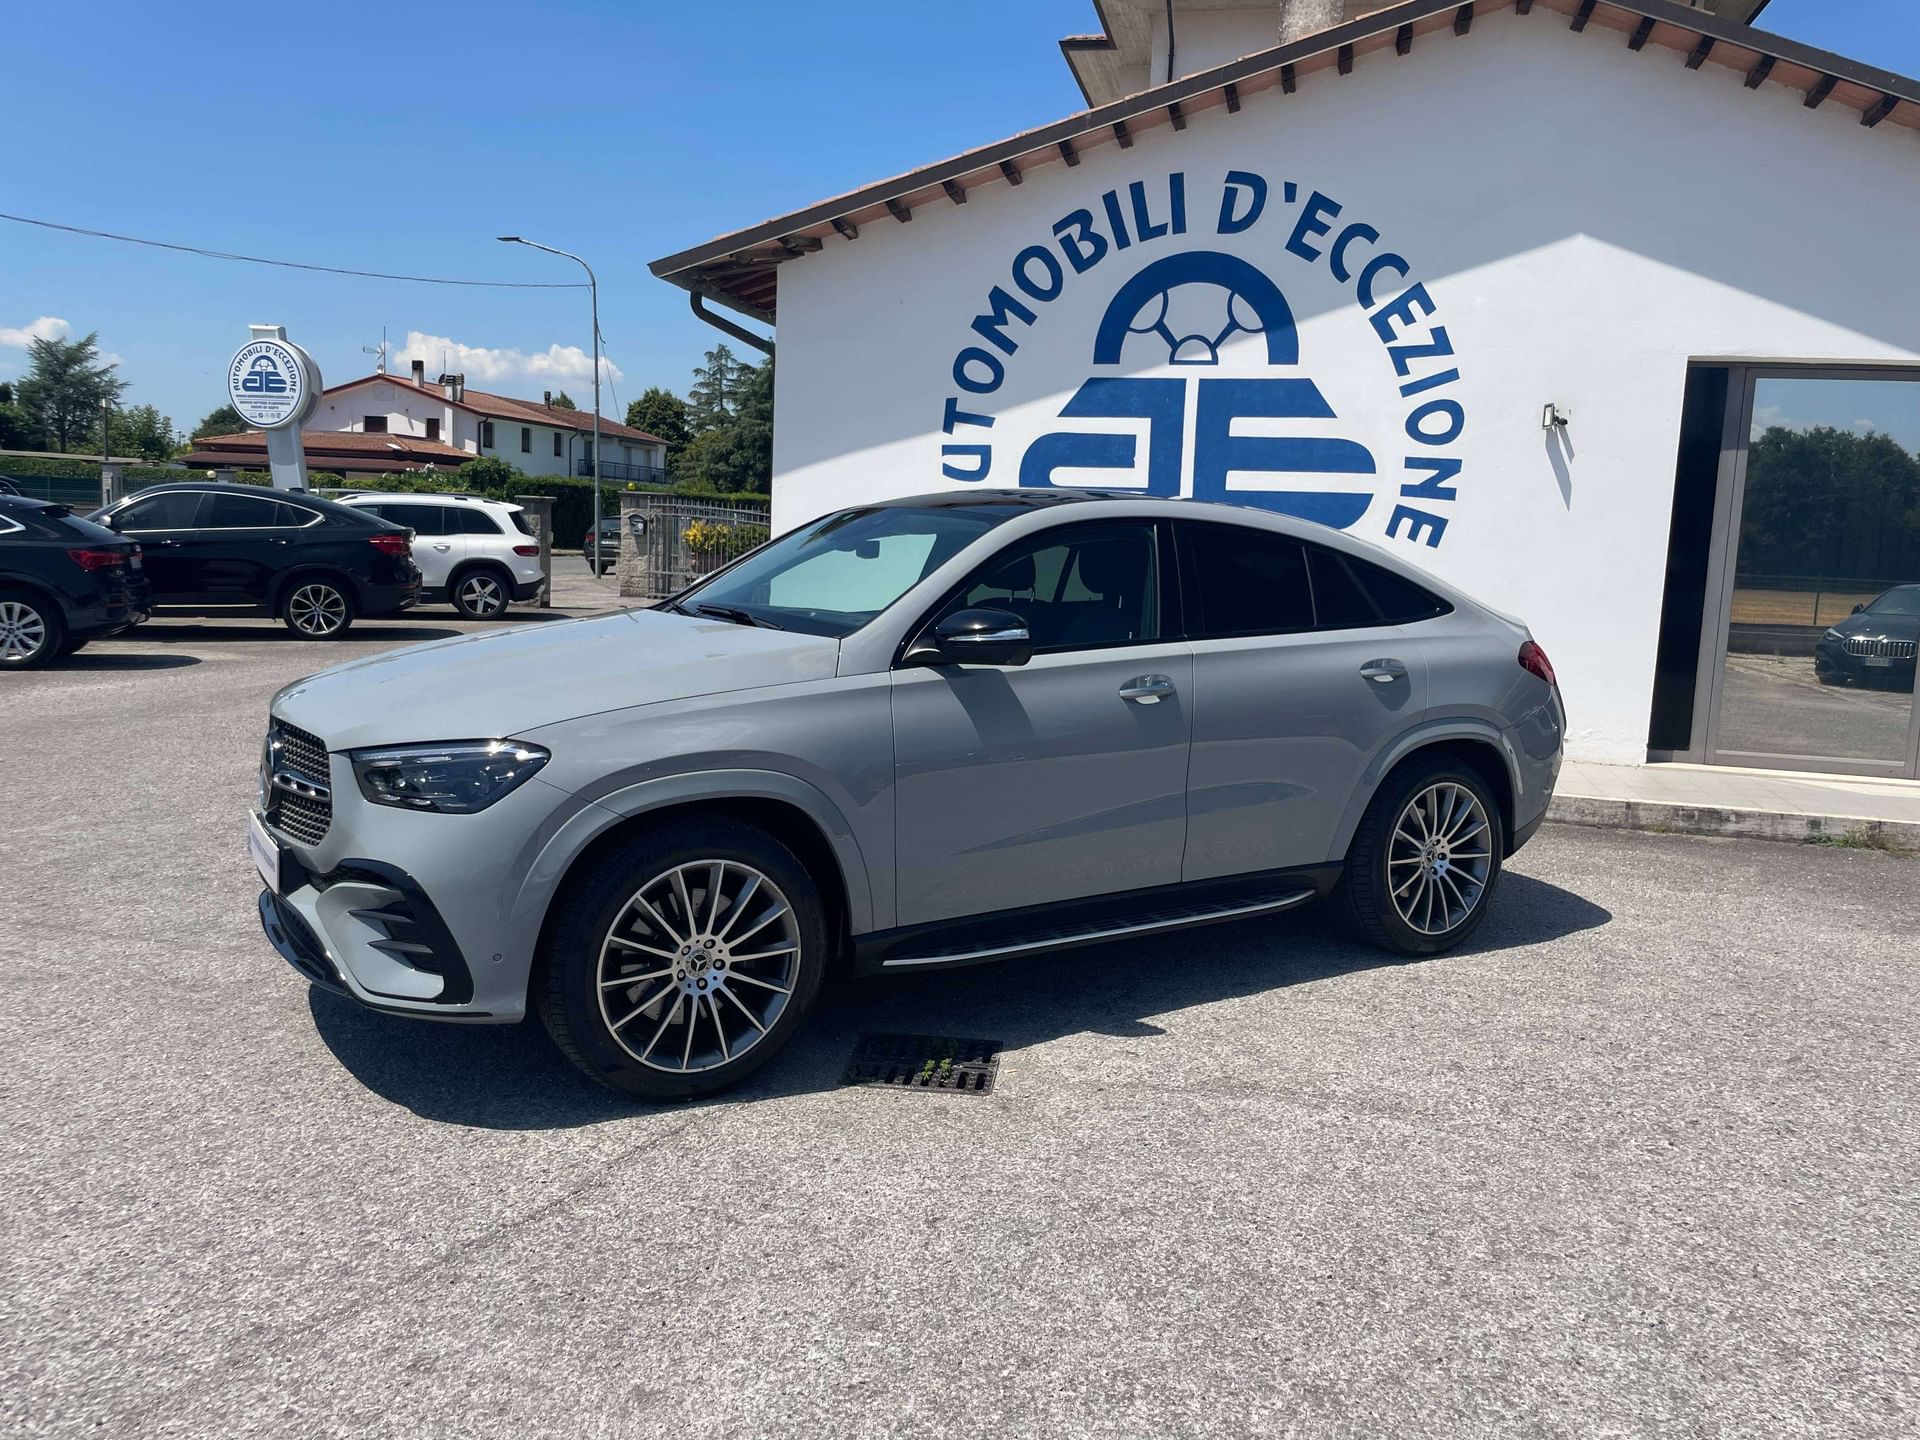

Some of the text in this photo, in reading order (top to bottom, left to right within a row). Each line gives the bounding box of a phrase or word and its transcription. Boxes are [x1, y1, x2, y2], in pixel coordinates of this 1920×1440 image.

[232, 345, 297, 394] AUTOMOBILI D'ECCEZIONE
[941, 170, 1465, 549] UTOMOBILI D'ECCEZIONE
